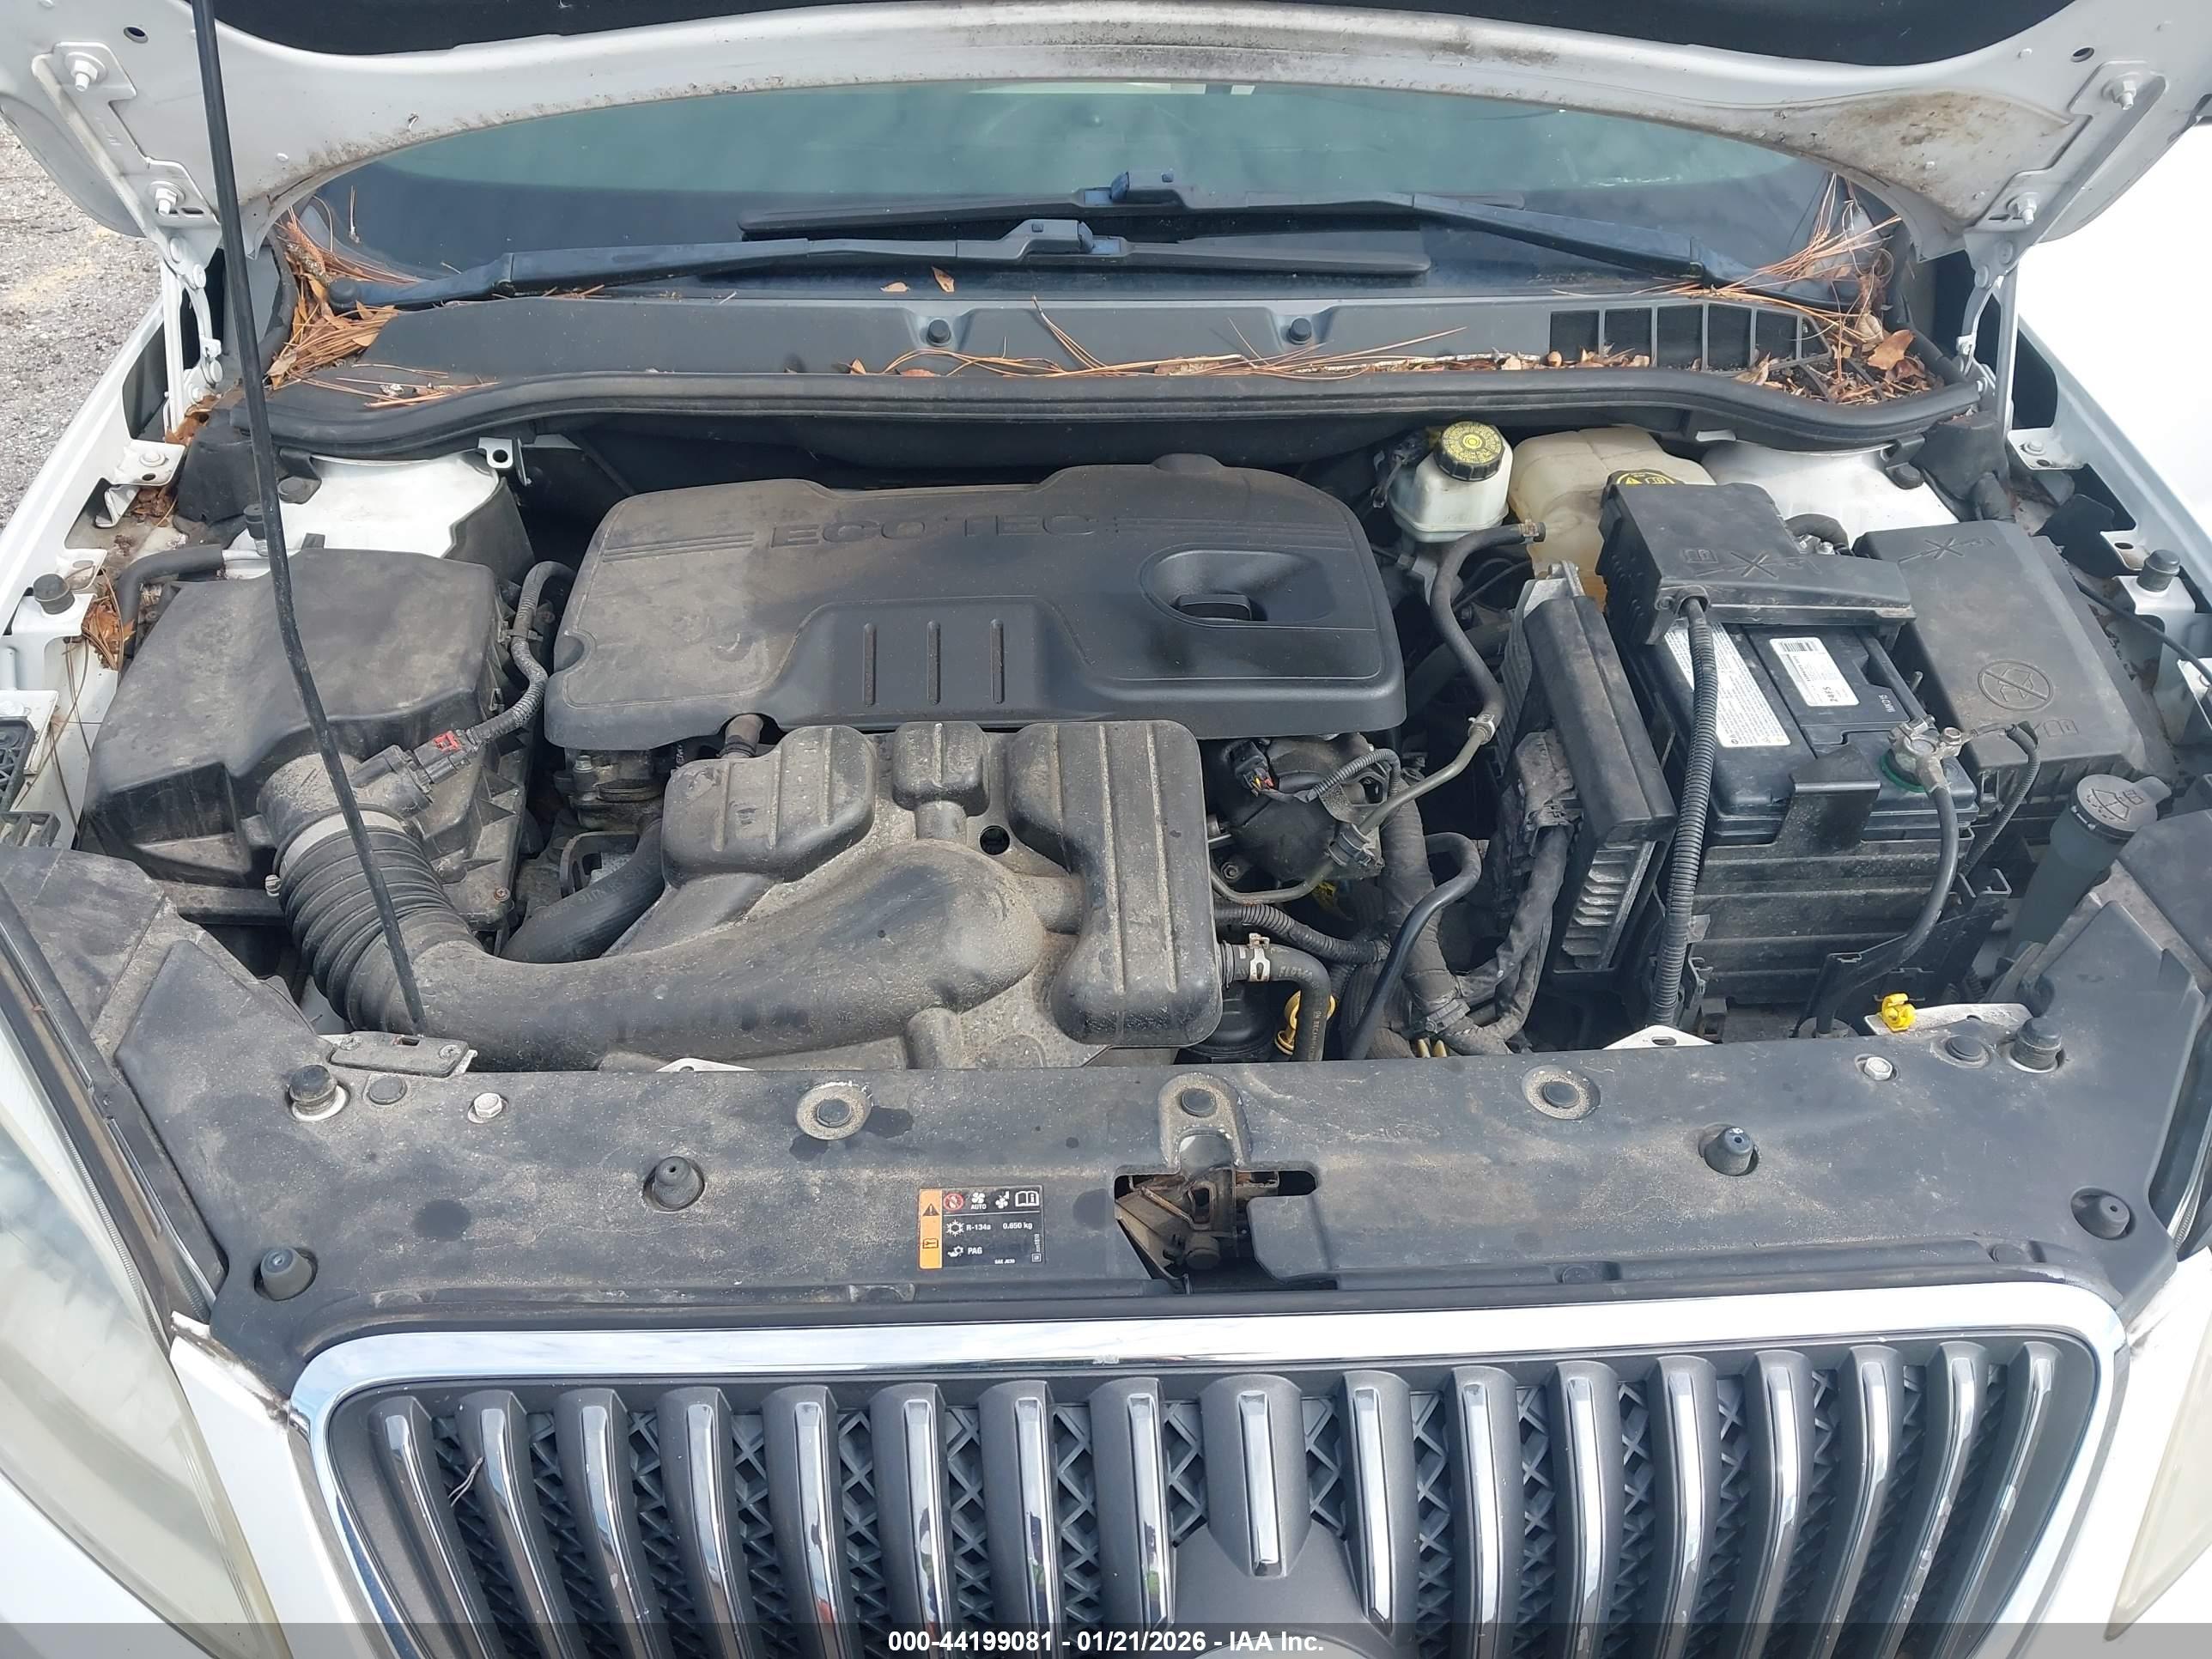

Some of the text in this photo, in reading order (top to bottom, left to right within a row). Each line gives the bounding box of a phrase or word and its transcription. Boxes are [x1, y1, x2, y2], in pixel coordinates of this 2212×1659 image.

[770, 514, 1098, 548] ECOTEC
[966, 1223, 991, 1231] R-134a
[1023, 1222, 1033, 1231] kg
